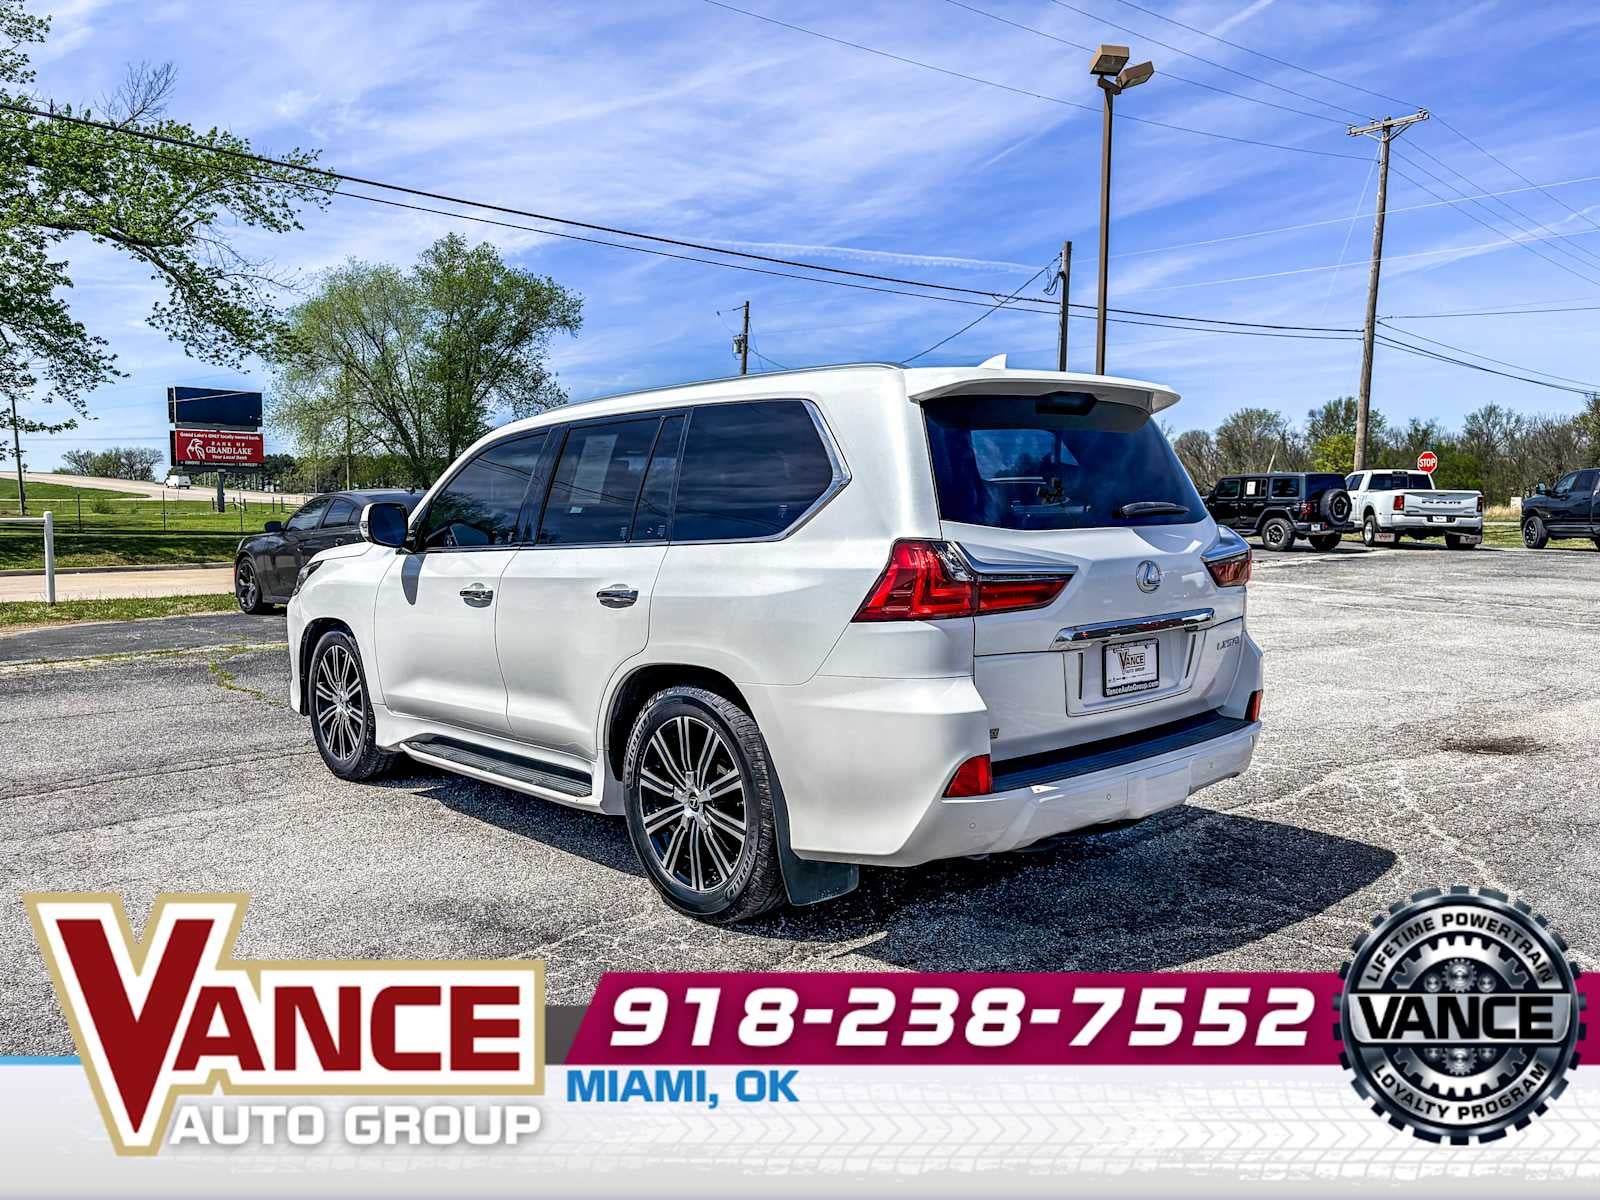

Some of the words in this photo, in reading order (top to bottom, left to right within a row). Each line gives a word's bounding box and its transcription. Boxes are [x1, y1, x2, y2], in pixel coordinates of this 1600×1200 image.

[206, 446, 232, 454] GRAND
[233, 447, 252, 455] LAKE
[1419, 459, 1436, 468] STOP
[1119, 650, 1144, 670] VANCE
[1105, 680, 1159, 696] VanceAutoGroup.com
